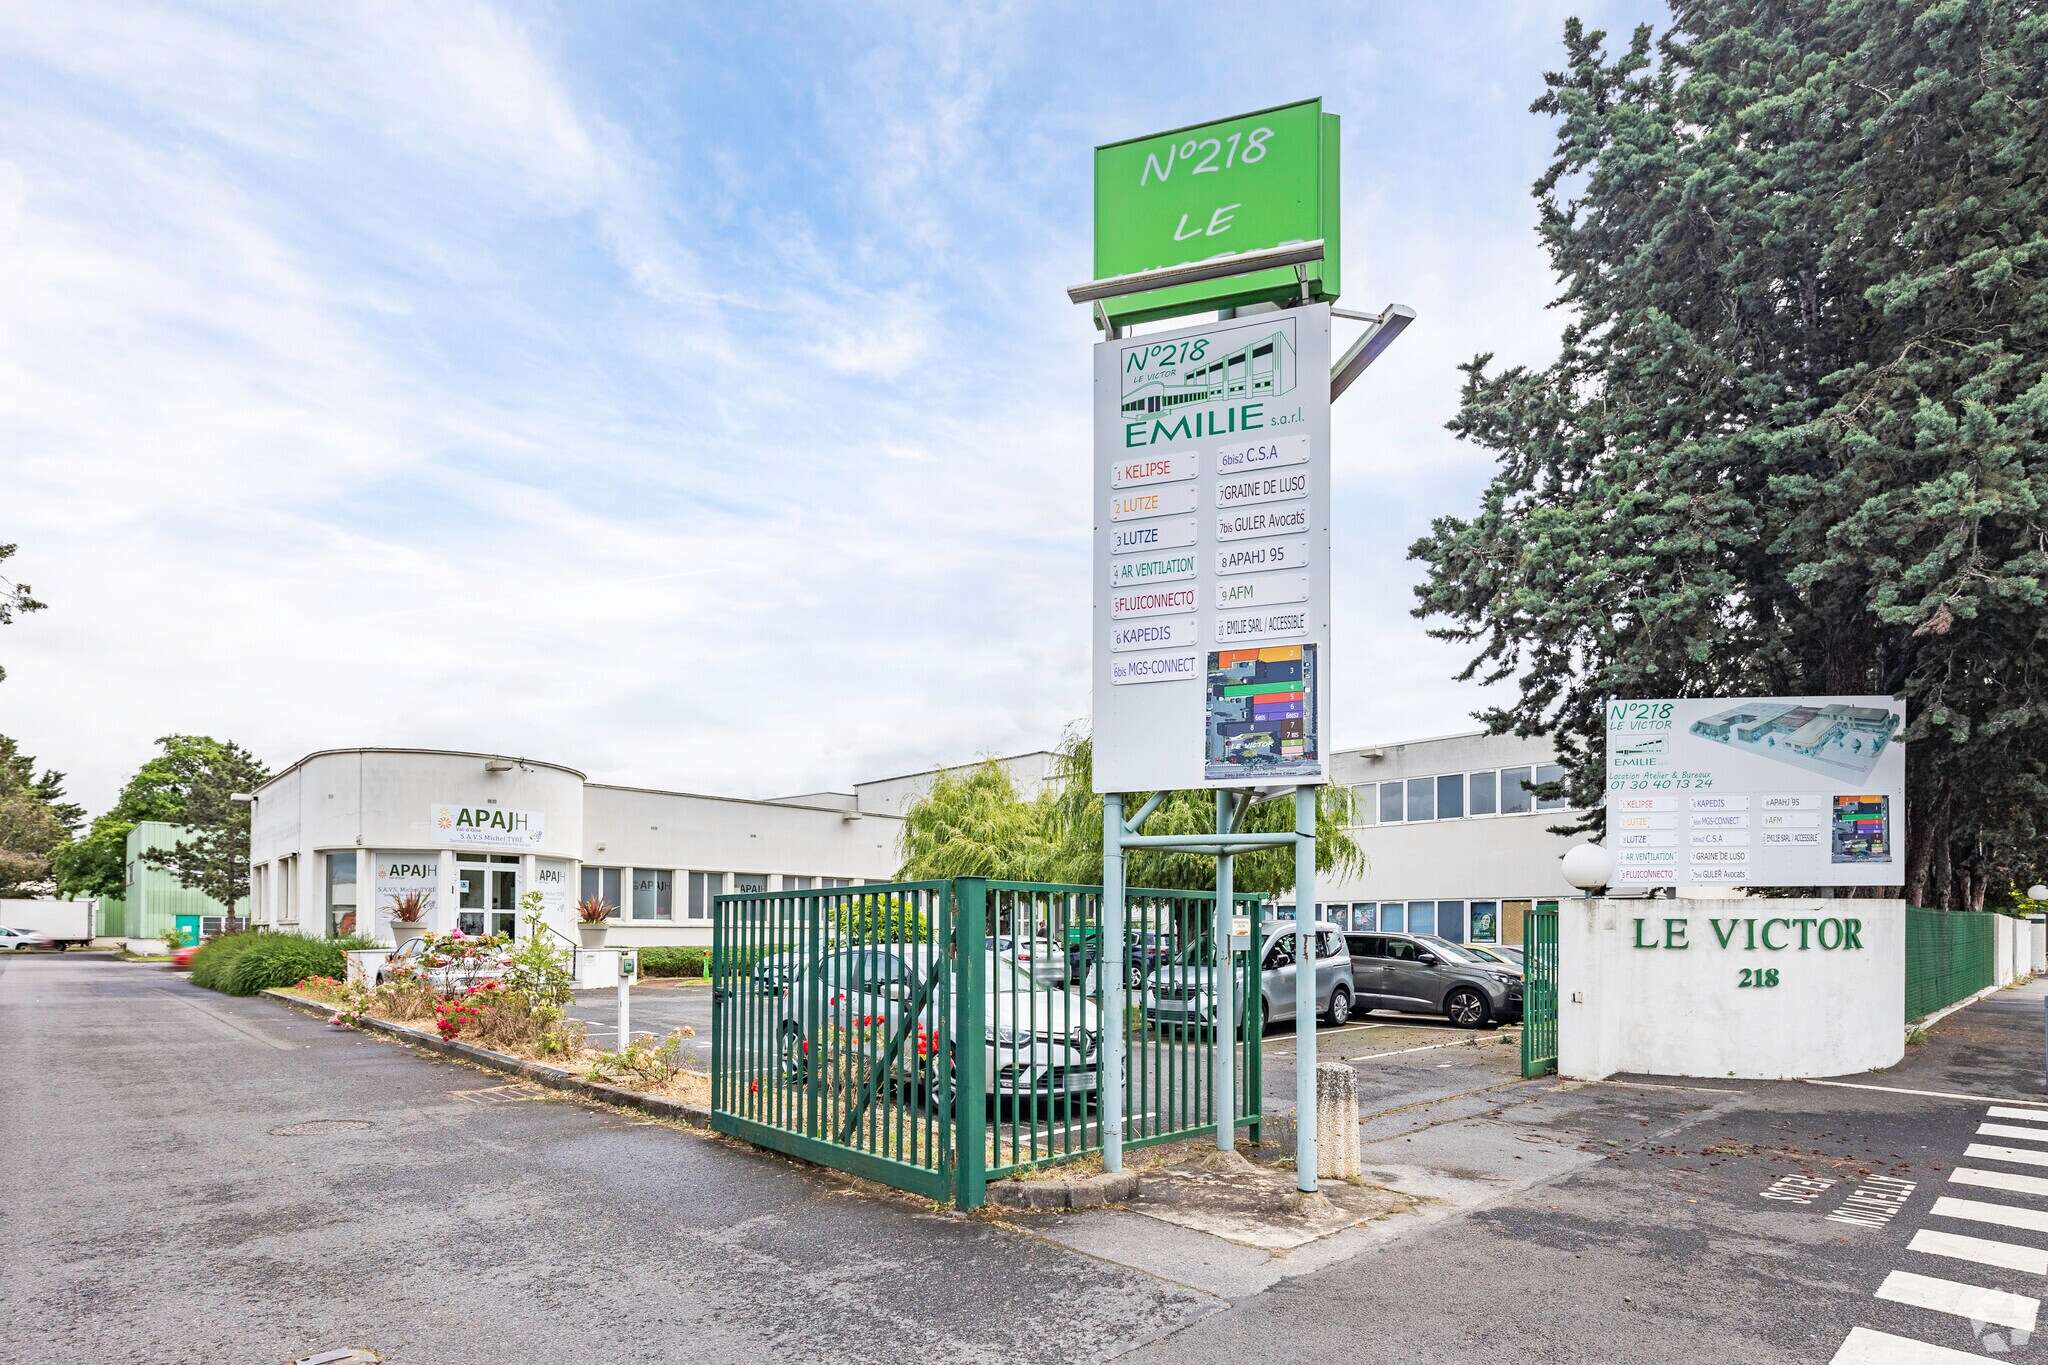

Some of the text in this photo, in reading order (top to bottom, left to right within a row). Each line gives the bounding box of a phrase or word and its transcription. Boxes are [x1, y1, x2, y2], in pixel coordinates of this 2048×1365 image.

[1173, 203, 1242, 241] LE
[1133, 369, 1177, 384] LE VICTOR
[1126, 403, 1305, 448] EMILIE s.a.r.l.
[1222, 445, 1278, 466] 6bis2 C.S.A
[1125, 460, 1171, 480] KELIPSE
[1224, 482, 1261, 500] GRAINE
[1263, 480, 1277, 494] DE
[1280, 475, 1306, 493] LUSO
[1123, 495, 1159, 513] LUTZE
[1234, 515, 1266, 532] GULER
[1269, 511, 1305, 528] Avocats
[1123, 528, 1158, 546] LUTZE
[1221, 547, 1284, 568] 8 APAHJ 95
[1121, 564, 1133, 579] AR
[1135, 556, 1194, 577] VENTILATION
[1228, 585, 1254, 600] AFM
[1120, 590, 1194, 612] FLUICONNECTO
[1226, 620, 1247, 635] EMILIE
[1248, 618, 1262, 634] SARL
[1268, 614, 1304, 632] ACCESSIBLE
[1122, 626, 1171, 644] KAPEDIS
[1128, 657, 1196, 676] MGS-CONNECT
[1609, 720, 1672, 730] LE VICTOR
[1244, 740, 1274, 749] VICTOR
[1614, 758, 1657, 766] EMILIE
[1609, 771, 1711, 780] Location Atelier & Bureaux
[1610, 779, 1713, 790] 01 30 40 13 24
[1627, 800, 1653, 809] KELIPSE
[1697, 799, 1725, 808] KAPEDIS
[1770, 798, 1790, 806] APAHJ
[1791, 798, 1800, 806] 95
[455, 808, 528, 833] APAJH
[1626, 818, 1647, 826] LUTZE
[1701, 817, 1740, 825] MGS-CONNECT
[1769, 816, 1783, 824] AFM
[484, 834, 506, 842] Michel
[1626, 835, 1647, 844] LUTZE
[1635, 852, 1674, 860] VENTILATION
[1696, 852, 1718, 860] GRAINE
[1720, 852, 1728, 860] DE
[1729, 852, 1746, 860] LUSO
[389, 864, 437, 879] APAJH
[539, 870, 566, 884] APAJH
[1626, 870, 1674, 879] FLUICONNECTO
[1702, 870, 1722, 878] GULER
[1724, 870, 1746, 878] Avocats
[1632, 917, 1864, 951] LE VICTOR
[1738, 968, 1779, 988] 218
